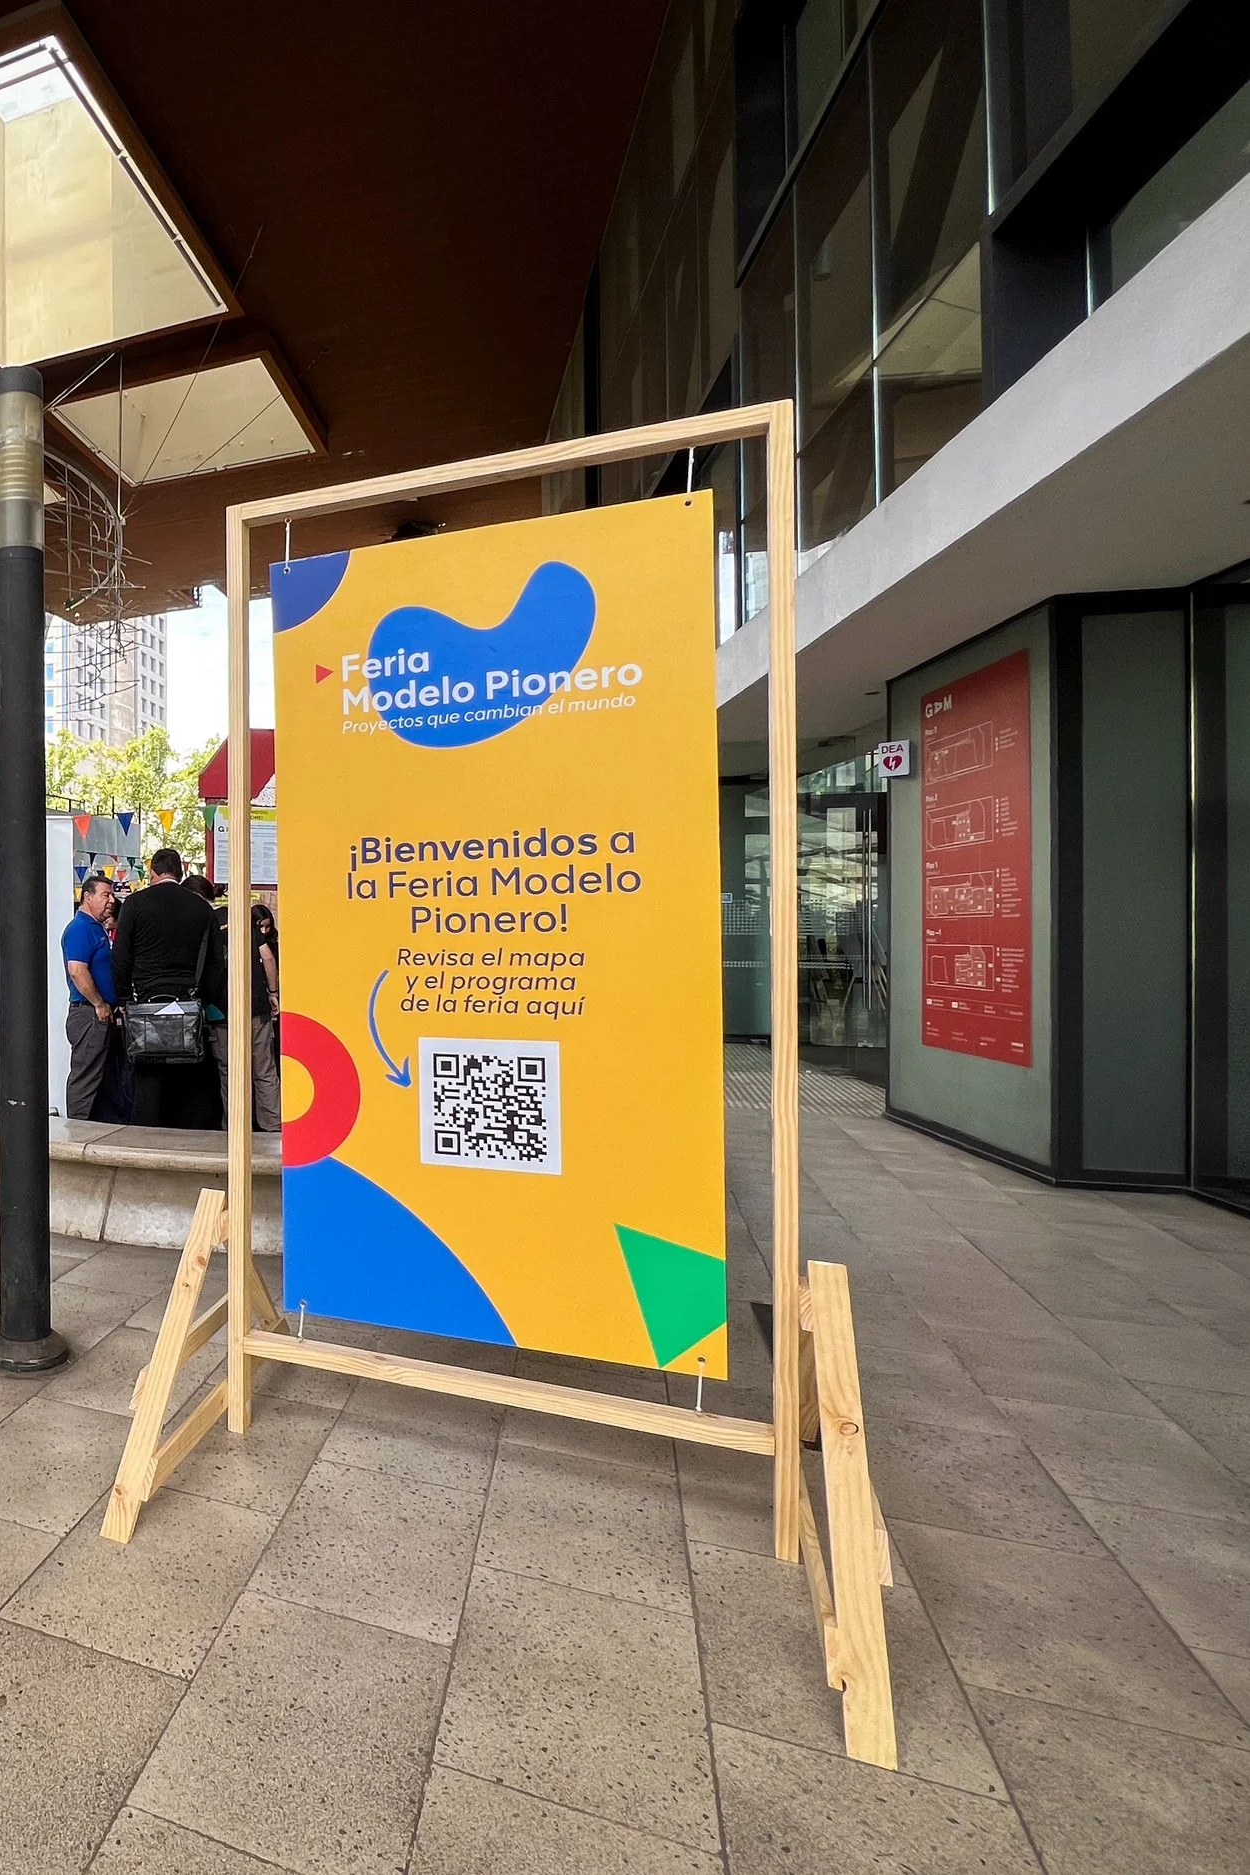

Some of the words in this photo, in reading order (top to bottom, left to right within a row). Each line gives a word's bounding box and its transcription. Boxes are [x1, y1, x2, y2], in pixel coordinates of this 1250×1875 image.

[342, 648, 430, 682] Feria
[342, 676, 475, 715] Modelo
[486, 662, 643, 700] Pionero
[342, 714, 423, 735] Proyectos
[427, 711, 460, 730] que
[464, 701, 543, 724] cambian
[548, 699, 564, 714] el
[568, 692, 636, 712] mundo
[881, 743, 904, 754] DEA
[350, 828, 598, 872] ¡Bienvenidos
[610, 831, 635, 854] a
[347, 872, 378, 900] la
[388, 871, 478, 900] Feria
[492, 863, 641, 896] Modelo
[411, 903, 568, 934] Pionero!
[397, 947, 474, 966] Revisa
[481, 947, 503, 966] el
[509, 952, 585, 971] mapa
[405, 975, 419, 993] y
[424, 971, 445, 990] el
[449, 976, 576, 997] programa
[400, 993, 430, 1012] de
[436, 994, 457, 1012] la
[463, 994, 519, 1014] feria
[526, 996, 585, 1020] aquí
